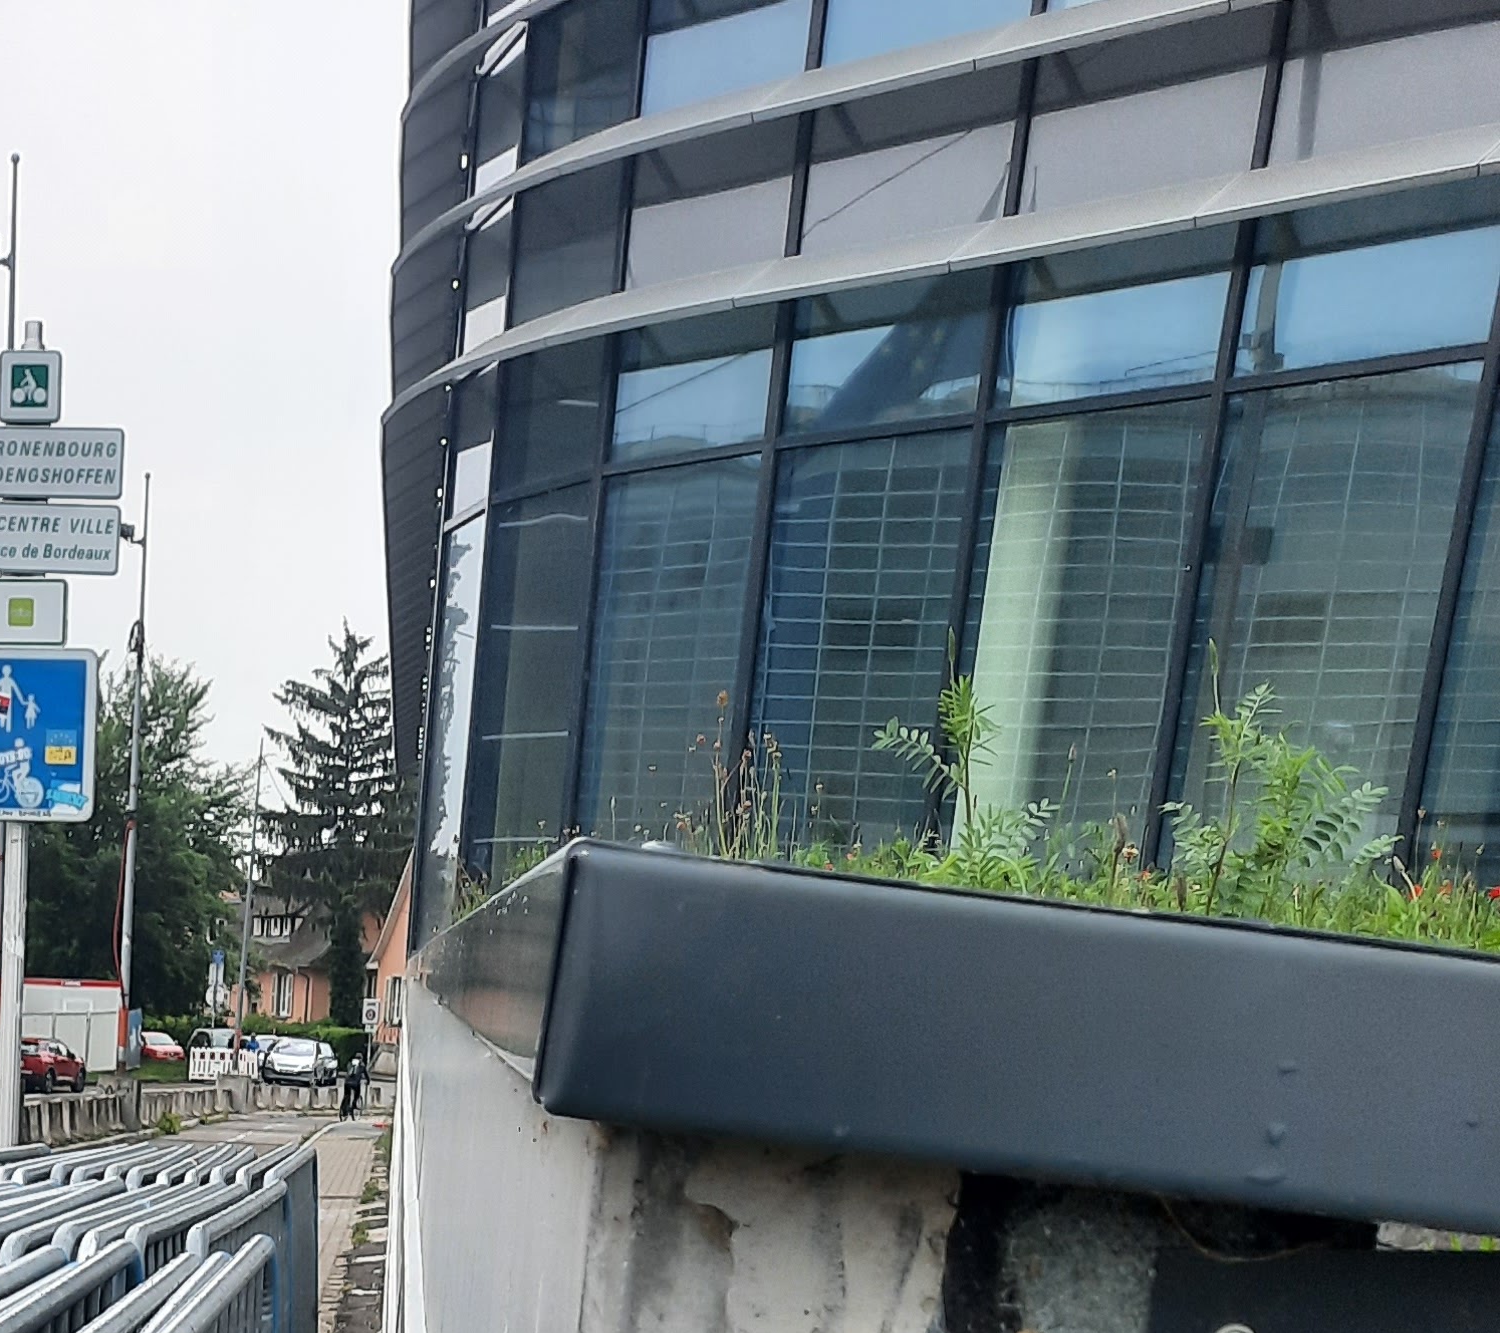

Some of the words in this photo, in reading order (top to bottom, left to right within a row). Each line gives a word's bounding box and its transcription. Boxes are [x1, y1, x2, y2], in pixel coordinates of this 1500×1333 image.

[69, 517, 115, 534] VILLE
[21, 542, 39, 558] de
[42, 543, 112, 560] Bordeaux
